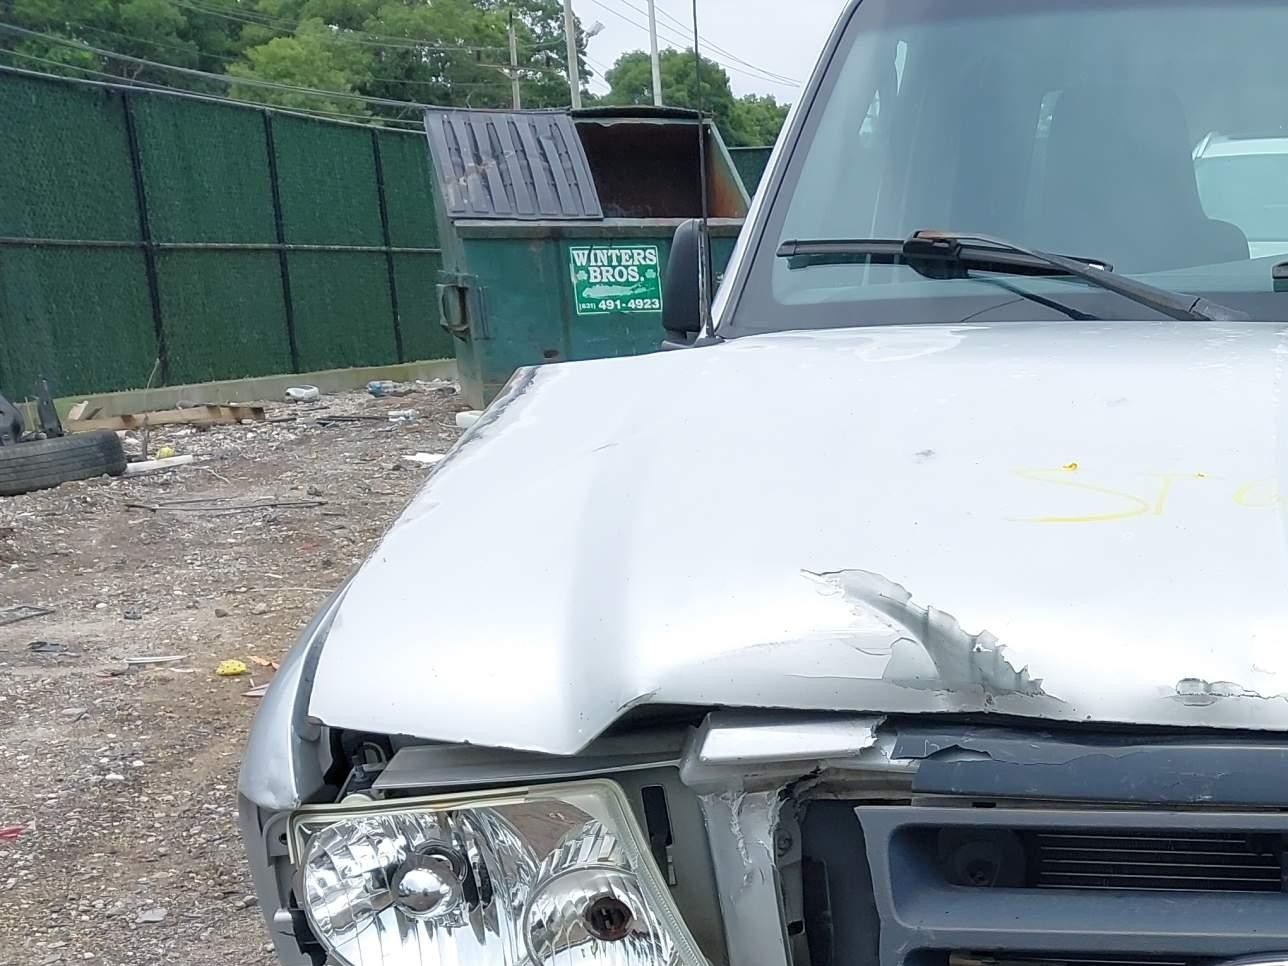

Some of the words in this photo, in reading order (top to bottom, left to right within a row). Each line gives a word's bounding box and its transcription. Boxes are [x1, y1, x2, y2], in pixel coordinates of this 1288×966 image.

[572, 248, 657, 266] WINTERS
[588, 266, 645, 282] BROS.
[598, 298, 660, 310] 491-4923
